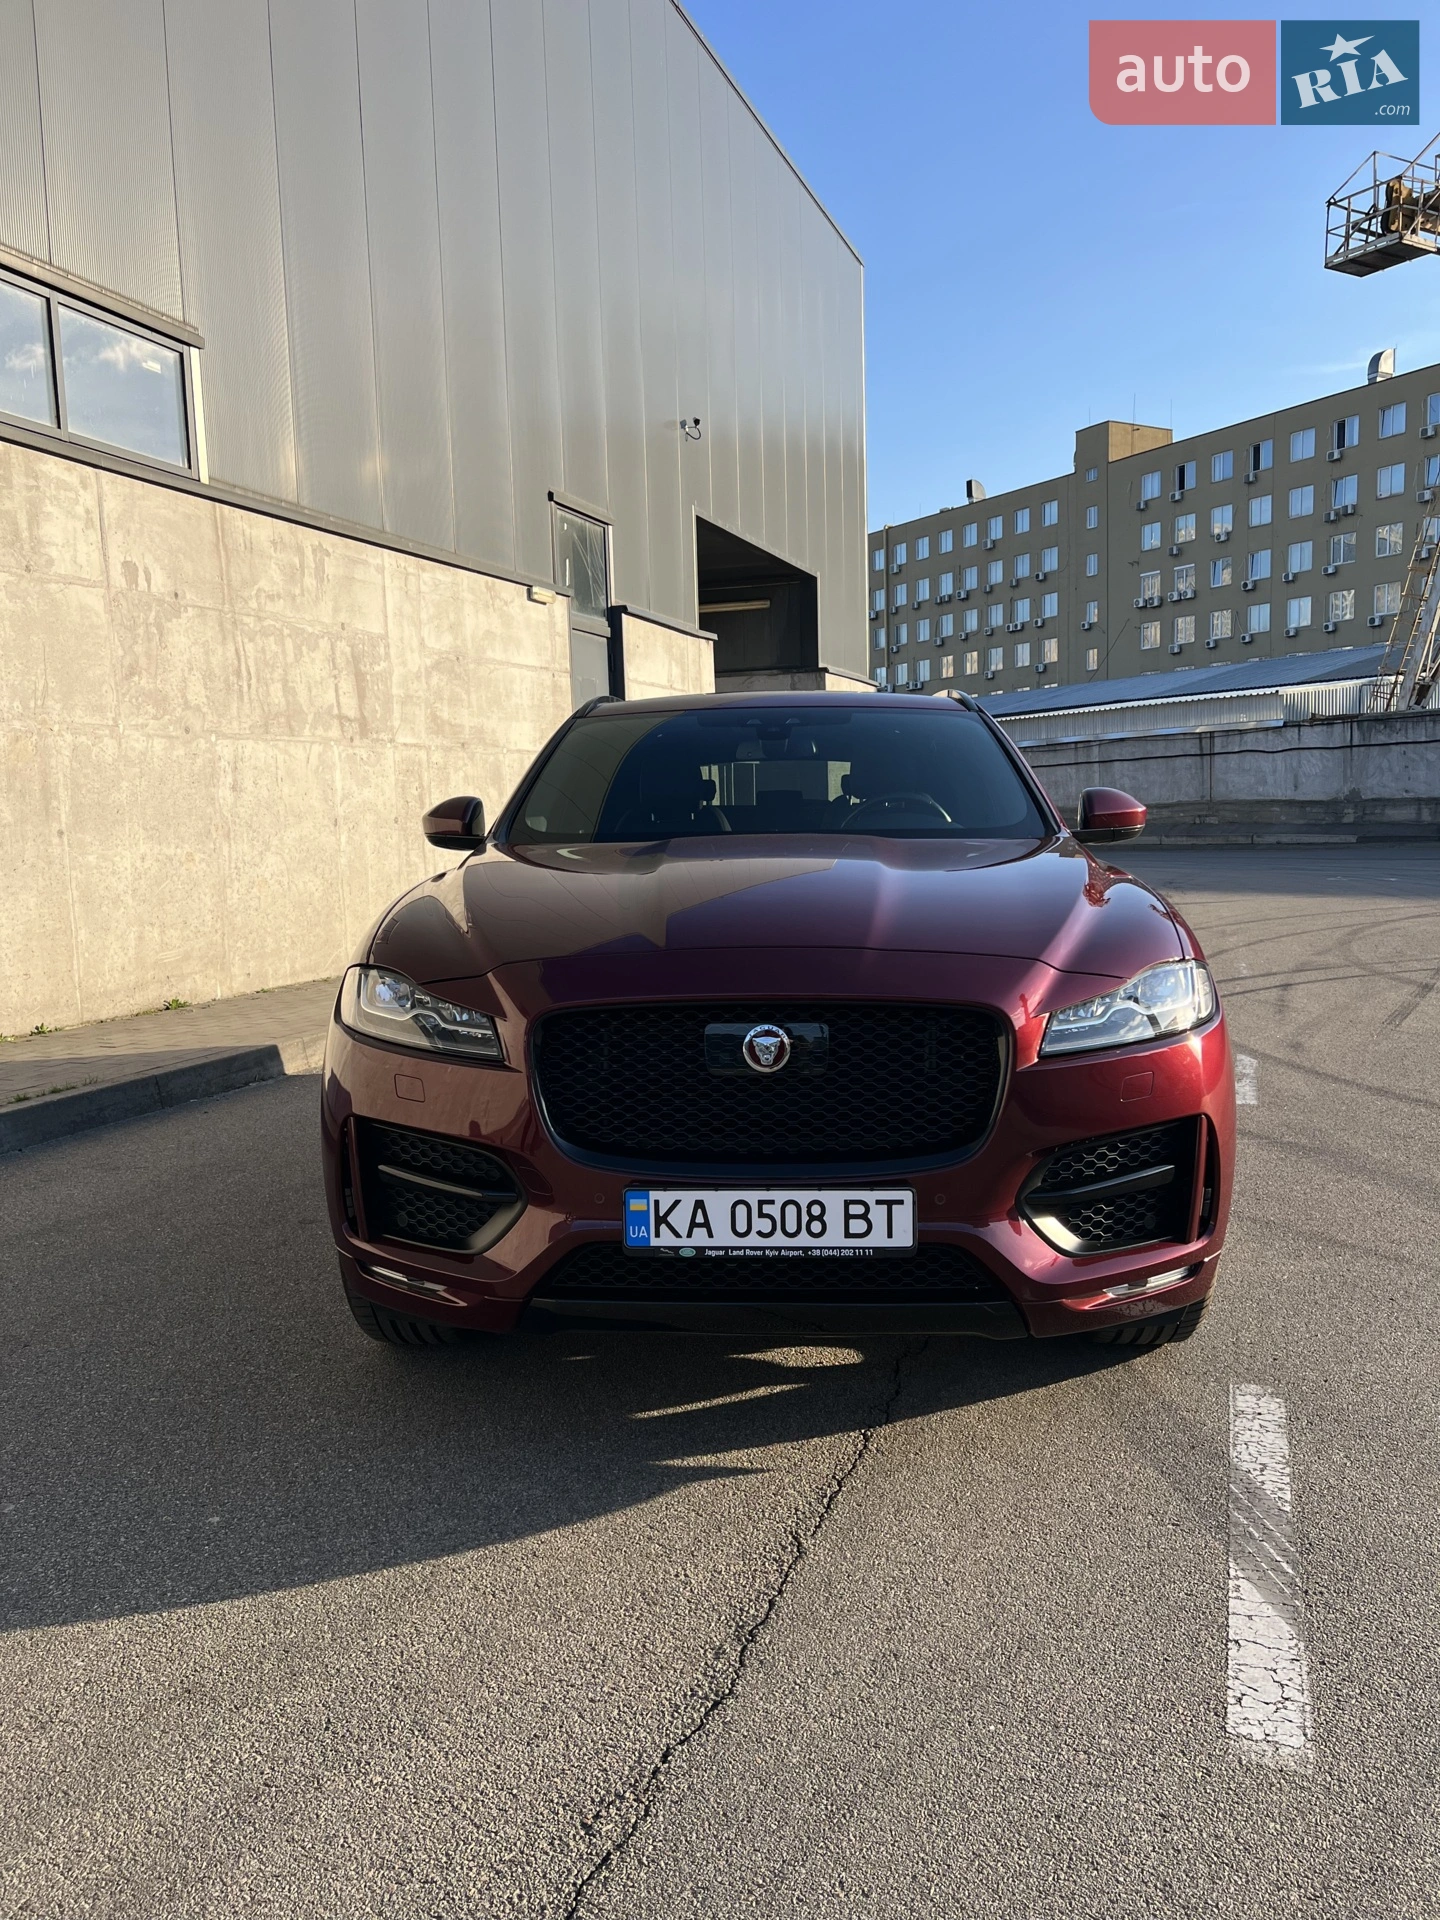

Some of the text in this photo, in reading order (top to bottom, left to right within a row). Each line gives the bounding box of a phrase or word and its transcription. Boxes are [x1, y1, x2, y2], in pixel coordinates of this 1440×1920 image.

[748, 1025, 787, 1040] JAGUAR
[653, 1198, 905, 1239] KA 0508 BT
[629, 1225, 649, 1238] UA
[704, 1248, 726, 1257] Jaguar
[728, 1248, 745, 1256] Land
[745, 1248, 764, 1256] Rover
[765, 1248, 779, 1257] Kyiv
[780, 1248, 805, 1257] Airport,
[807, 1248, 821, 1256] +38
[821, 1248, 840, 1257] (044)
[840, 1248, 854, 1256] 202
[855, 1248, 863, 1256] 11
[864, 1248, 873, 1256] 11
